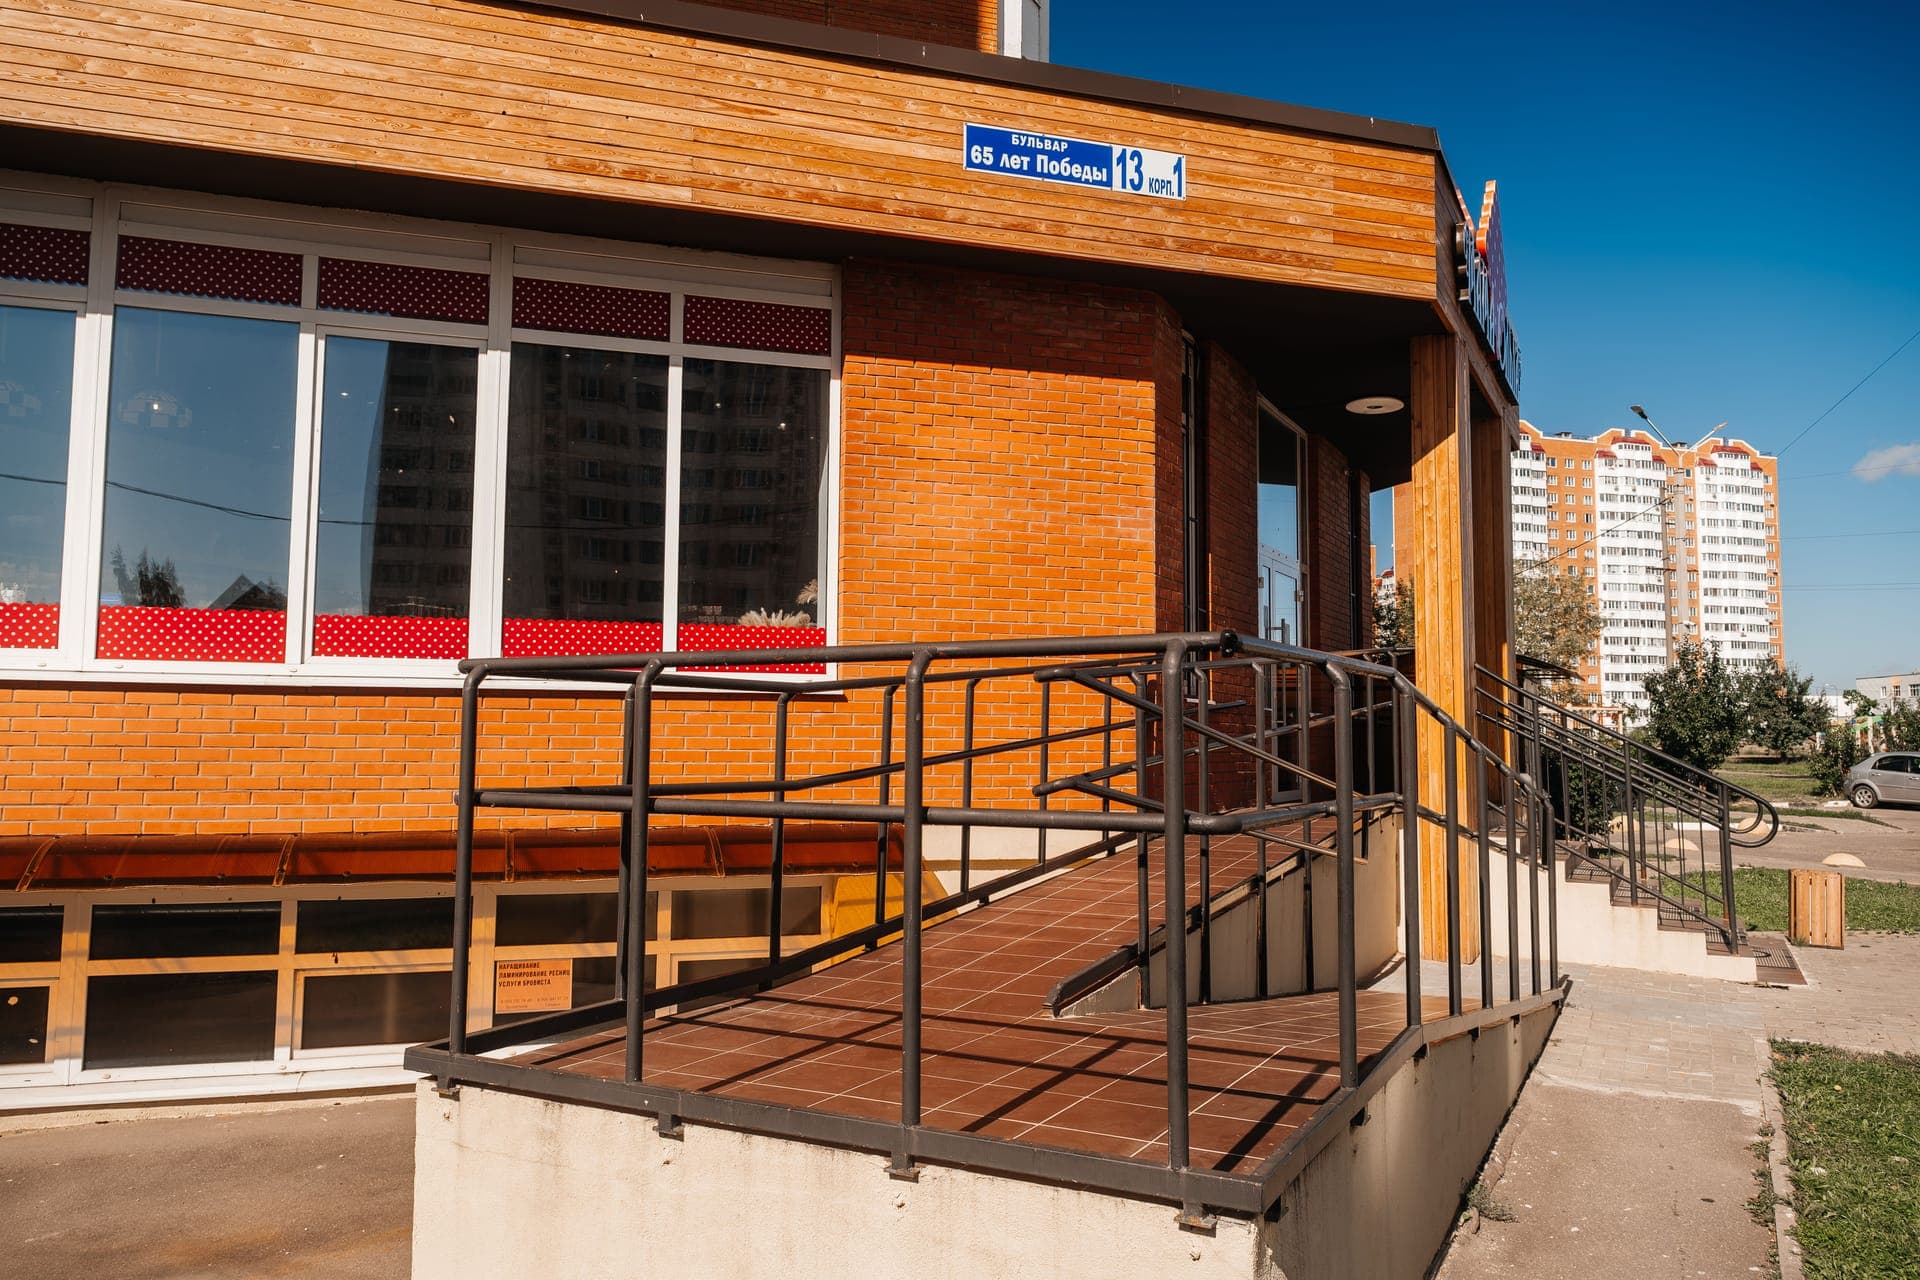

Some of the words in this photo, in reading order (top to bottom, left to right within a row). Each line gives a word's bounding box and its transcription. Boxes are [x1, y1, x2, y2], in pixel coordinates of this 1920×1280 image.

[1011, 134, 1068, 152] БУЛЬВАР
[970, 145, 994, 165] 65
[999, 152, 1030, 171] лет
[1036, 154, 1107, 183] Победы
[1116, 148, 1143, 191] 13
[1173, 156, 1182, 197] 1
